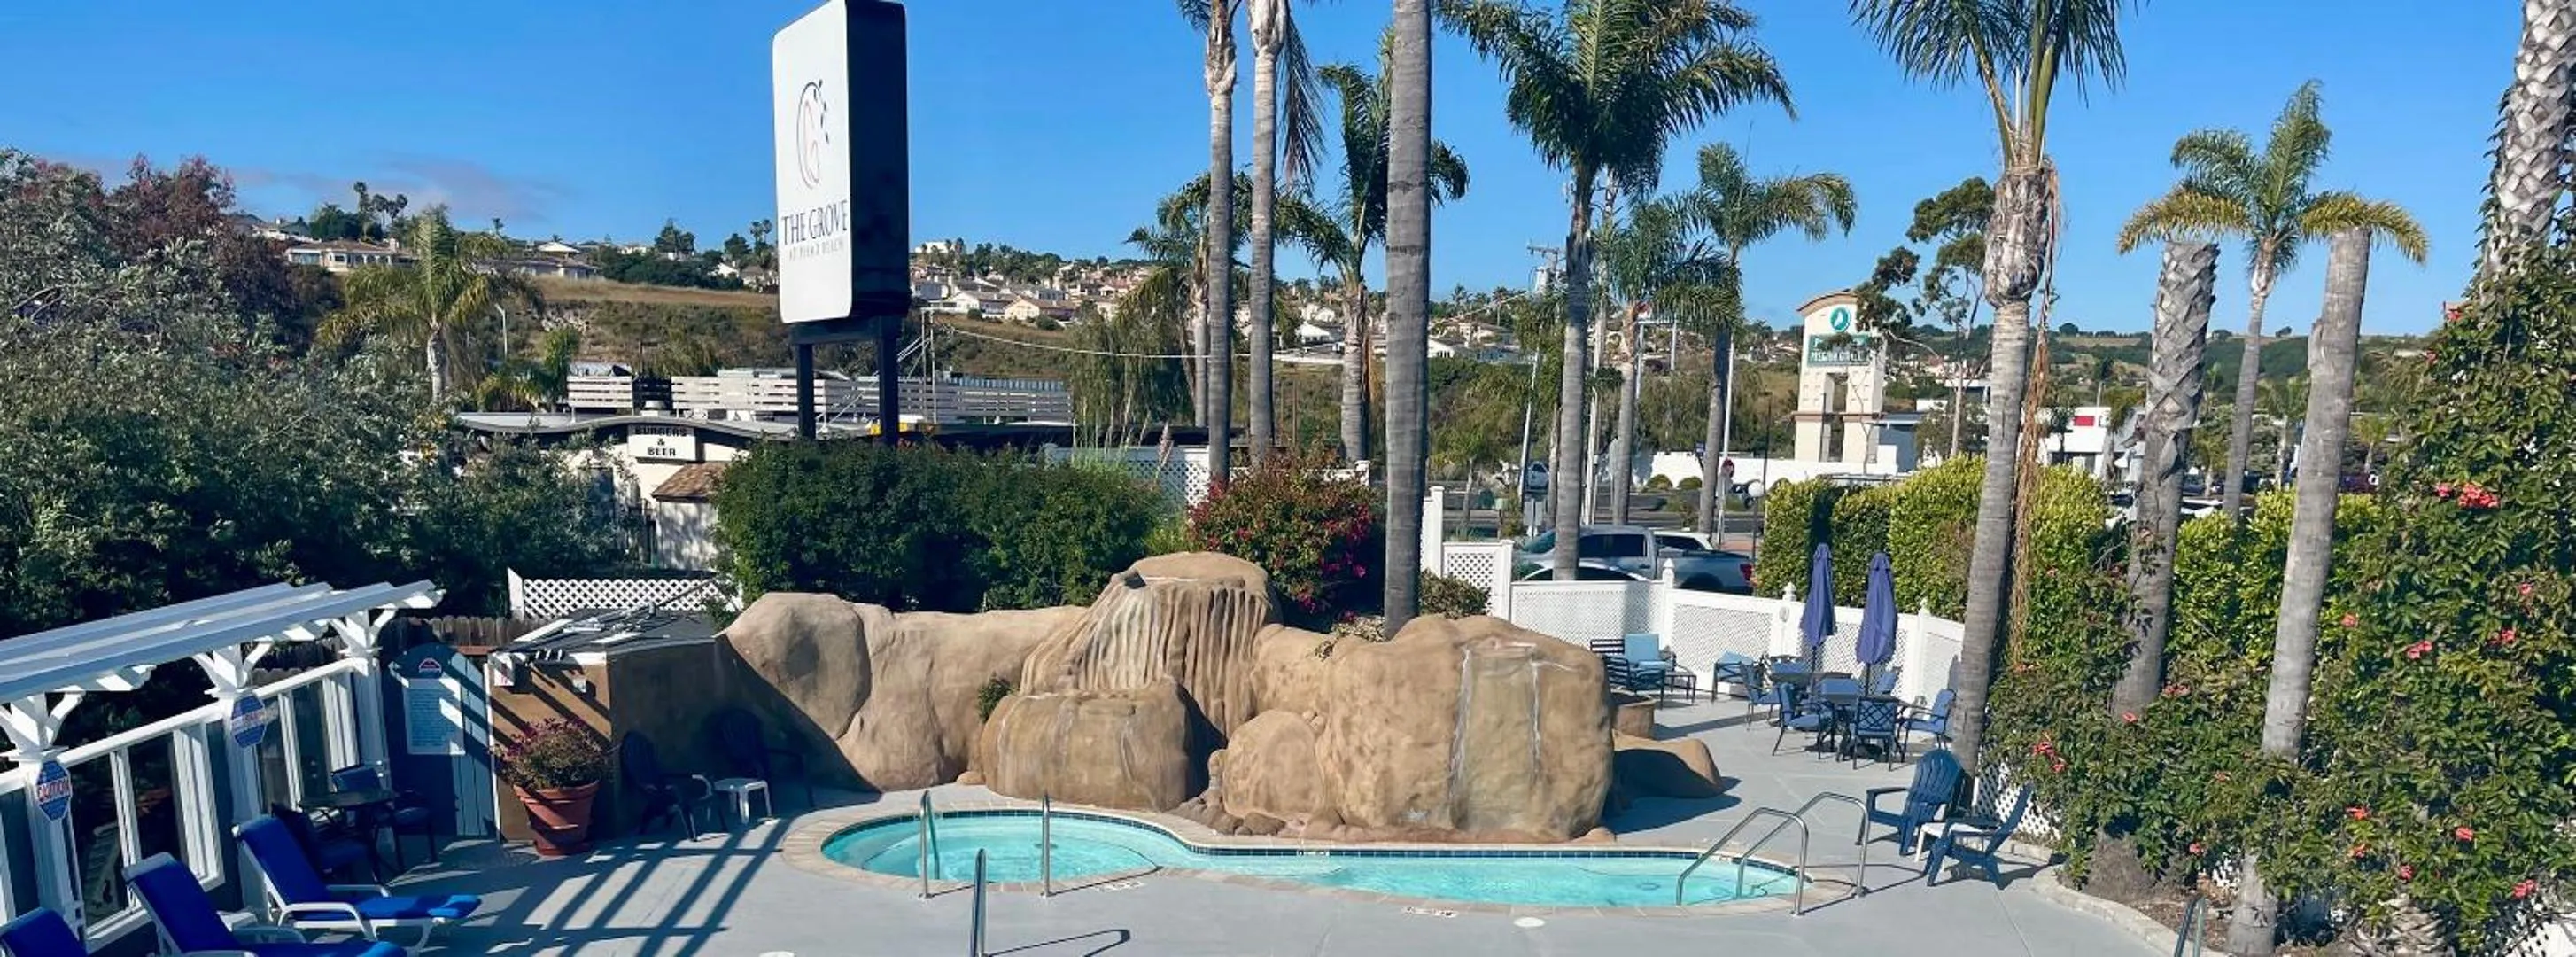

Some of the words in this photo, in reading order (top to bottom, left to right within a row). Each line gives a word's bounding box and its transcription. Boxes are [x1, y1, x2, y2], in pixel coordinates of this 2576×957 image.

[781, 213, 806, 245] THE
[809, 199, 848, 239] GROVE
[635, 425, 688, 436] BURGERS
[648, 447, 676, 456] BEER
